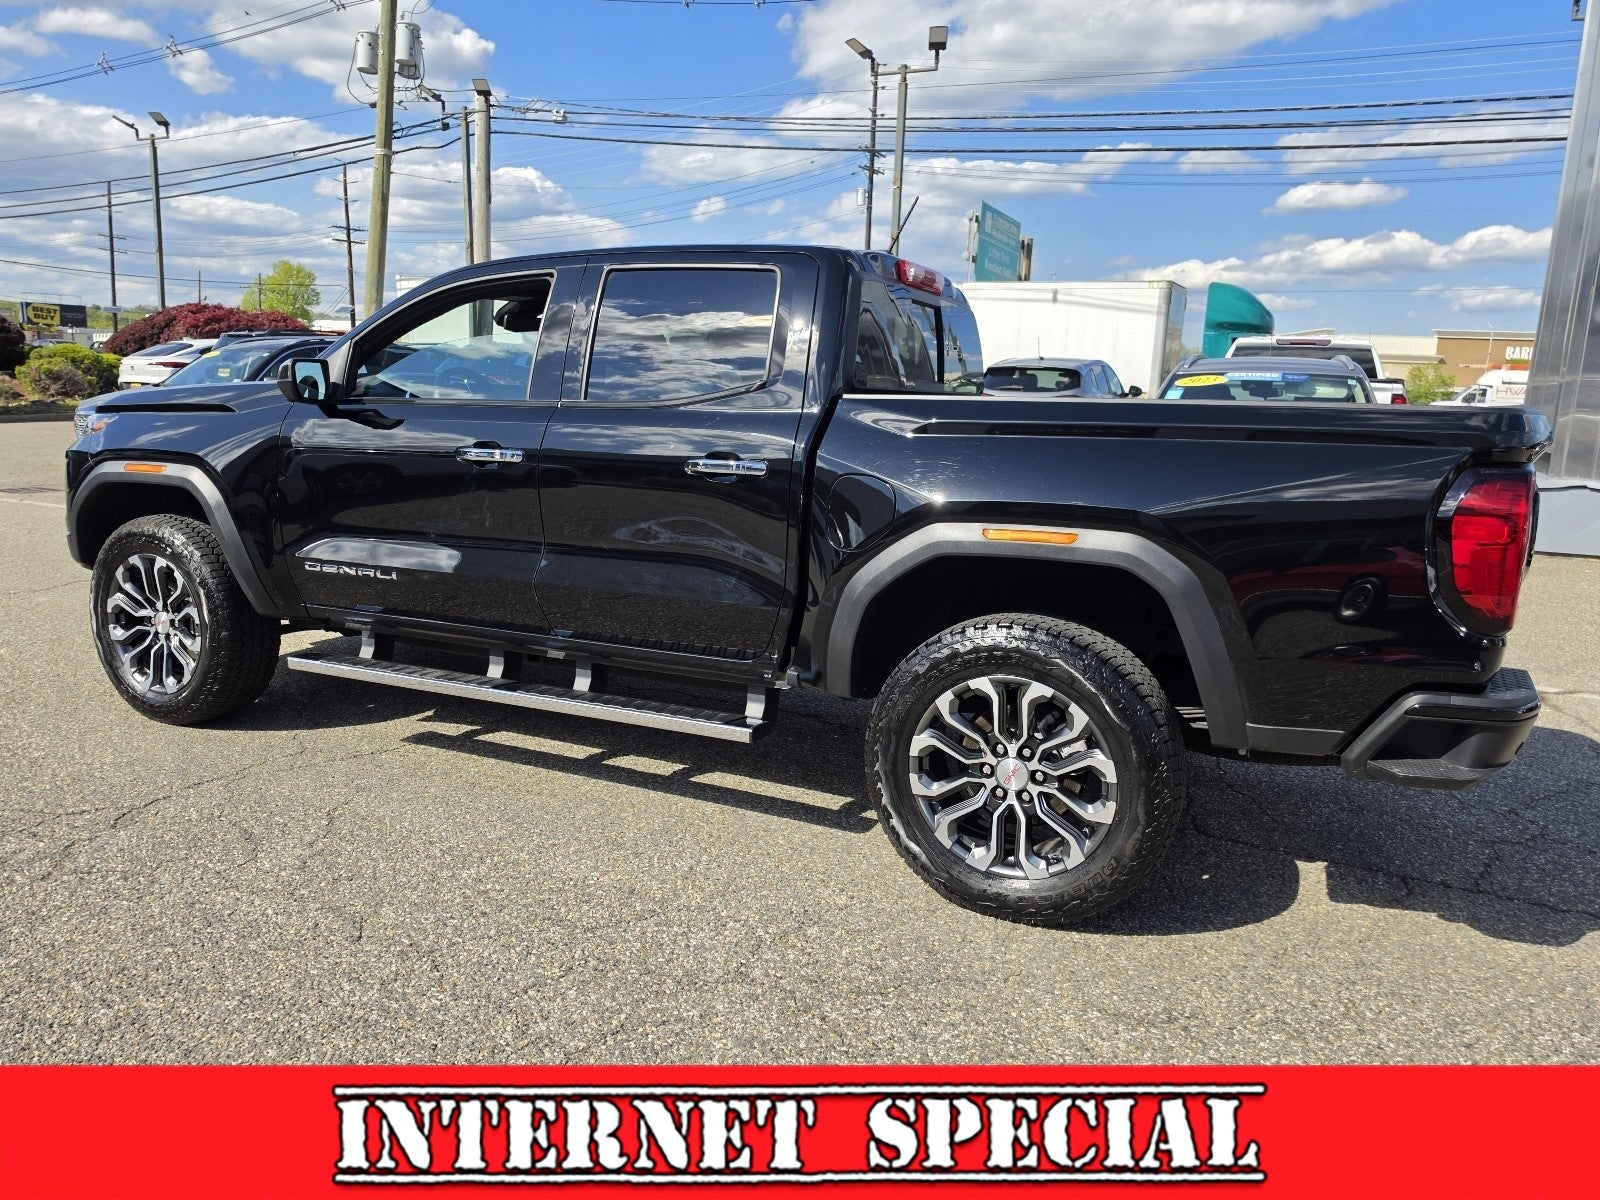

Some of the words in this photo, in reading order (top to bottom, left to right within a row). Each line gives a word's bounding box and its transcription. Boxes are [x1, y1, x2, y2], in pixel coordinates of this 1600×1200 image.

[32, 306, 58, 314] BEST
[304, 561, 398, 580] DENALI
[1003, 763, 1022, 785] GMC
